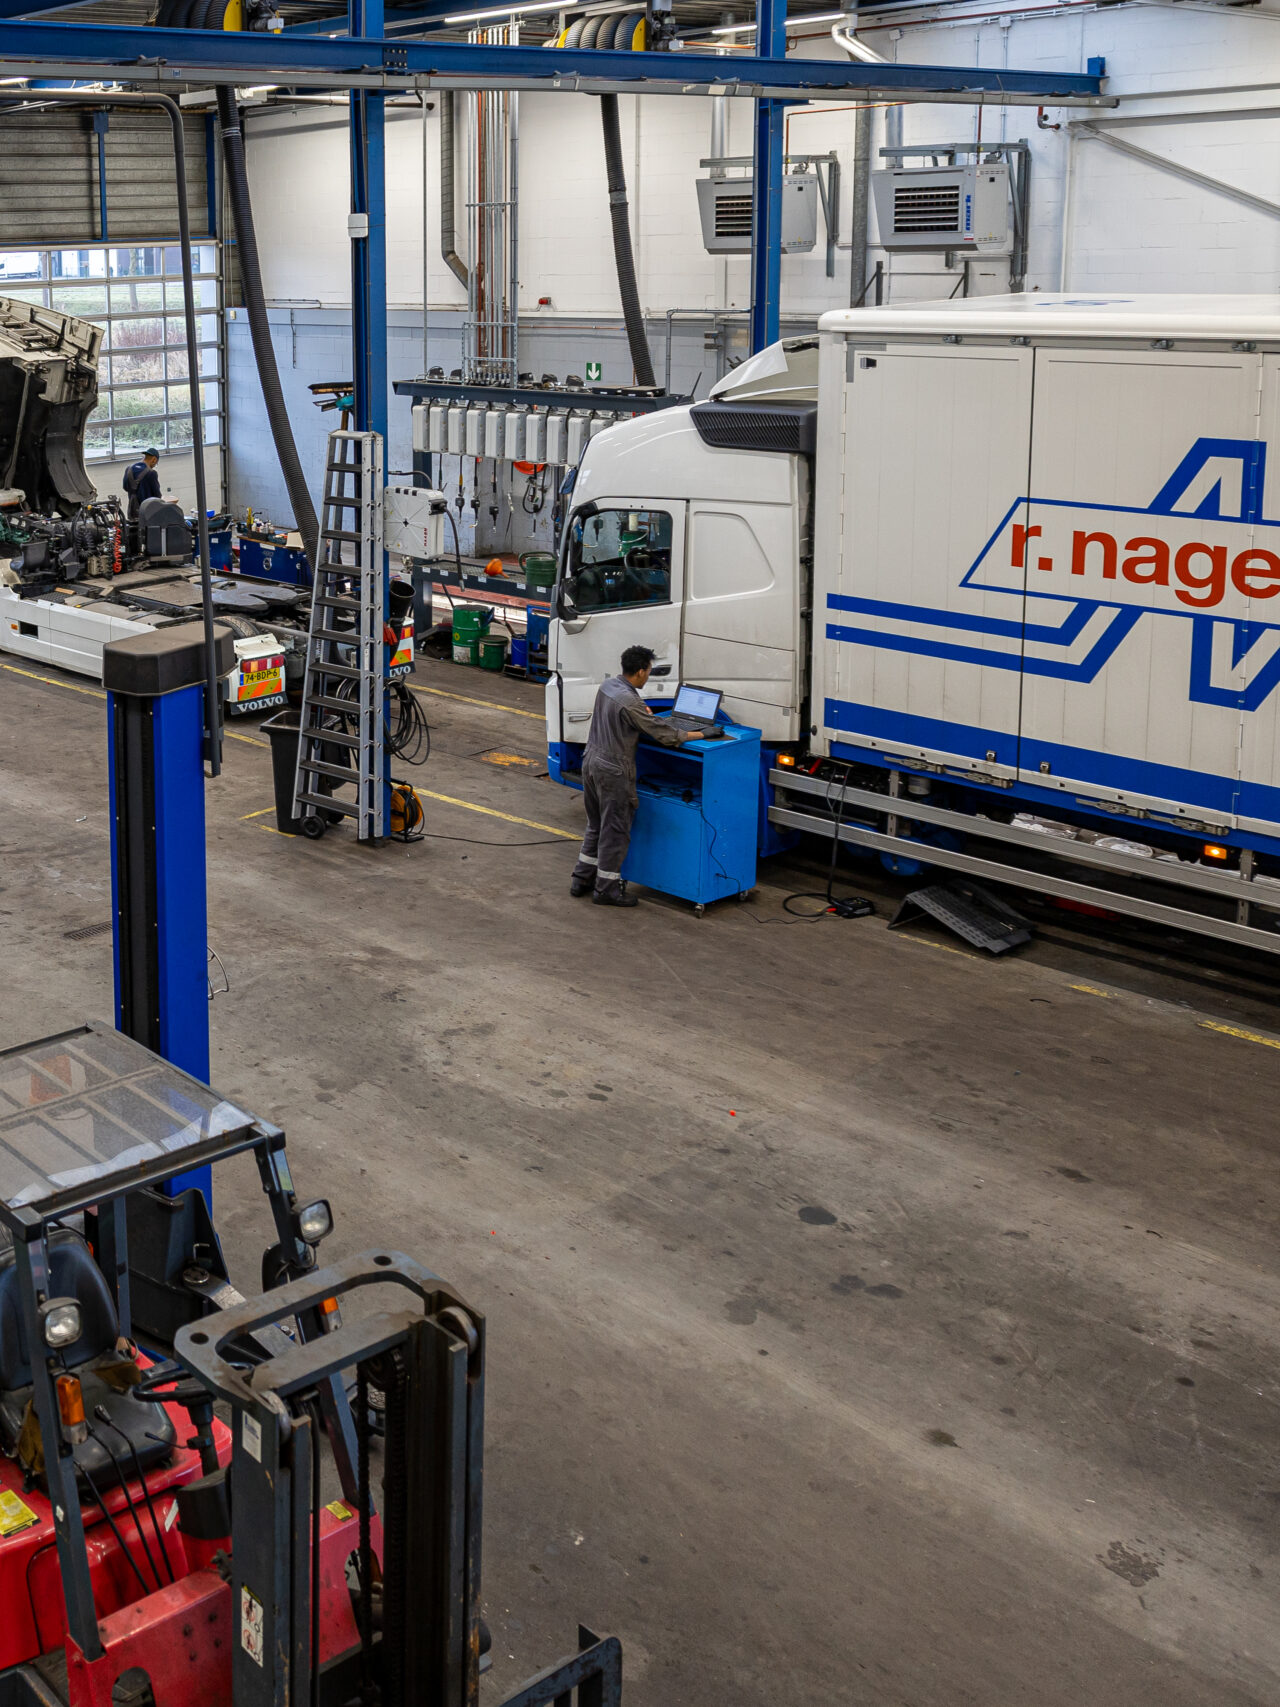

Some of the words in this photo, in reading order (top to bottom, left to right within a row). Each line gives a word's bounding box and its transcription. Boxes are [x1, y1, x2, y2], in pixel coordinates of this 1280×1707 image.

[244, 668, 278, 684] 74-BDP-6
[389, 665, 412, 678] LVO
[236, 695, 284, 713] VOLVO
